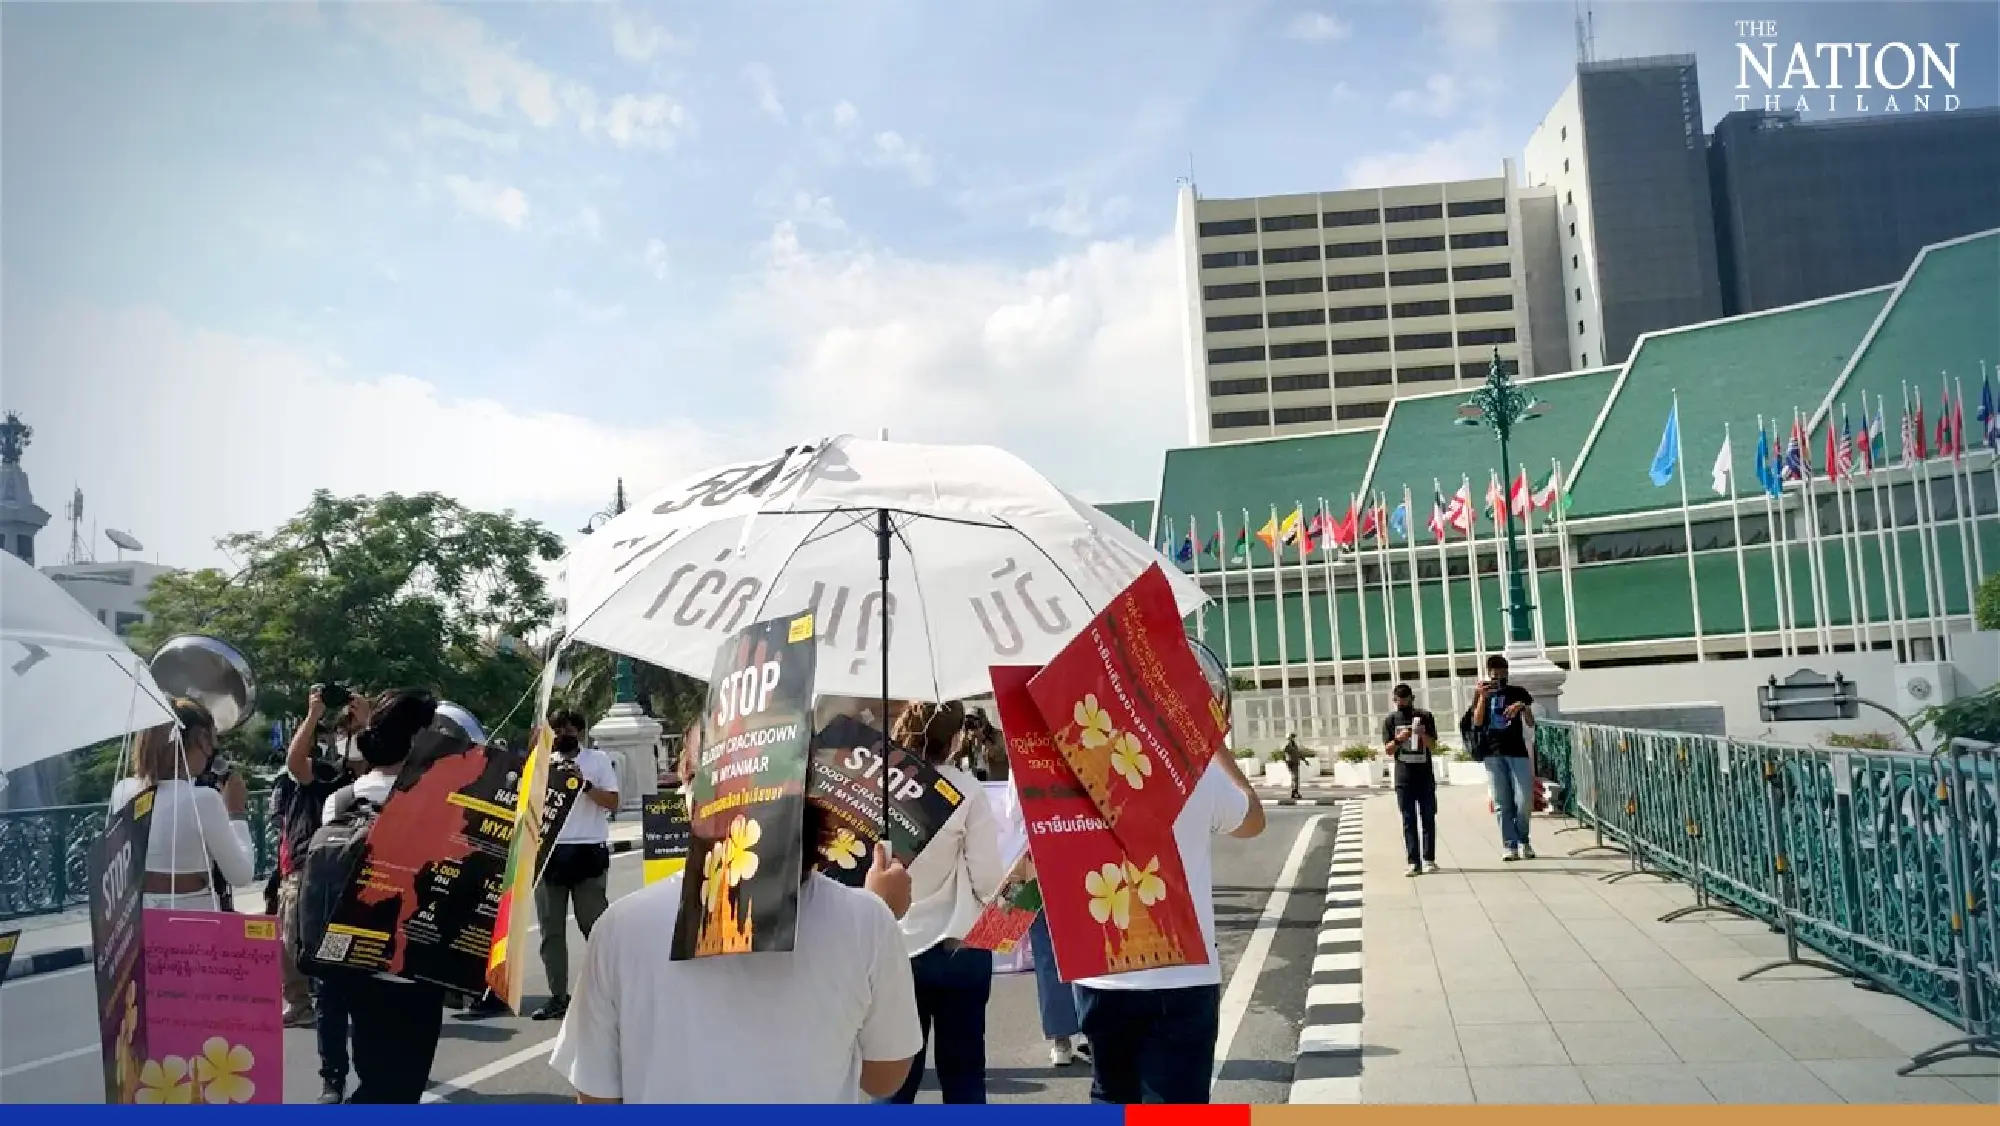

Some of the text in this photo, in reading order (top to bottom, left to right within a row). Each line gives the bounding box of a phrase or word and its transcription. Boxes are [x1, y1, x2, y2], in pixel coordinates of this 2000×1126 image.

[718, 661, 780, 727] STOP
[727, 724, 798, 755] CRACKDOWN
[844, 747, 924, 801] STOP
[835, 788, 891, 828] MYANMA
[851, 784, 919, 836] CRACDOWN
[102, 840, 132, 921] STOP
